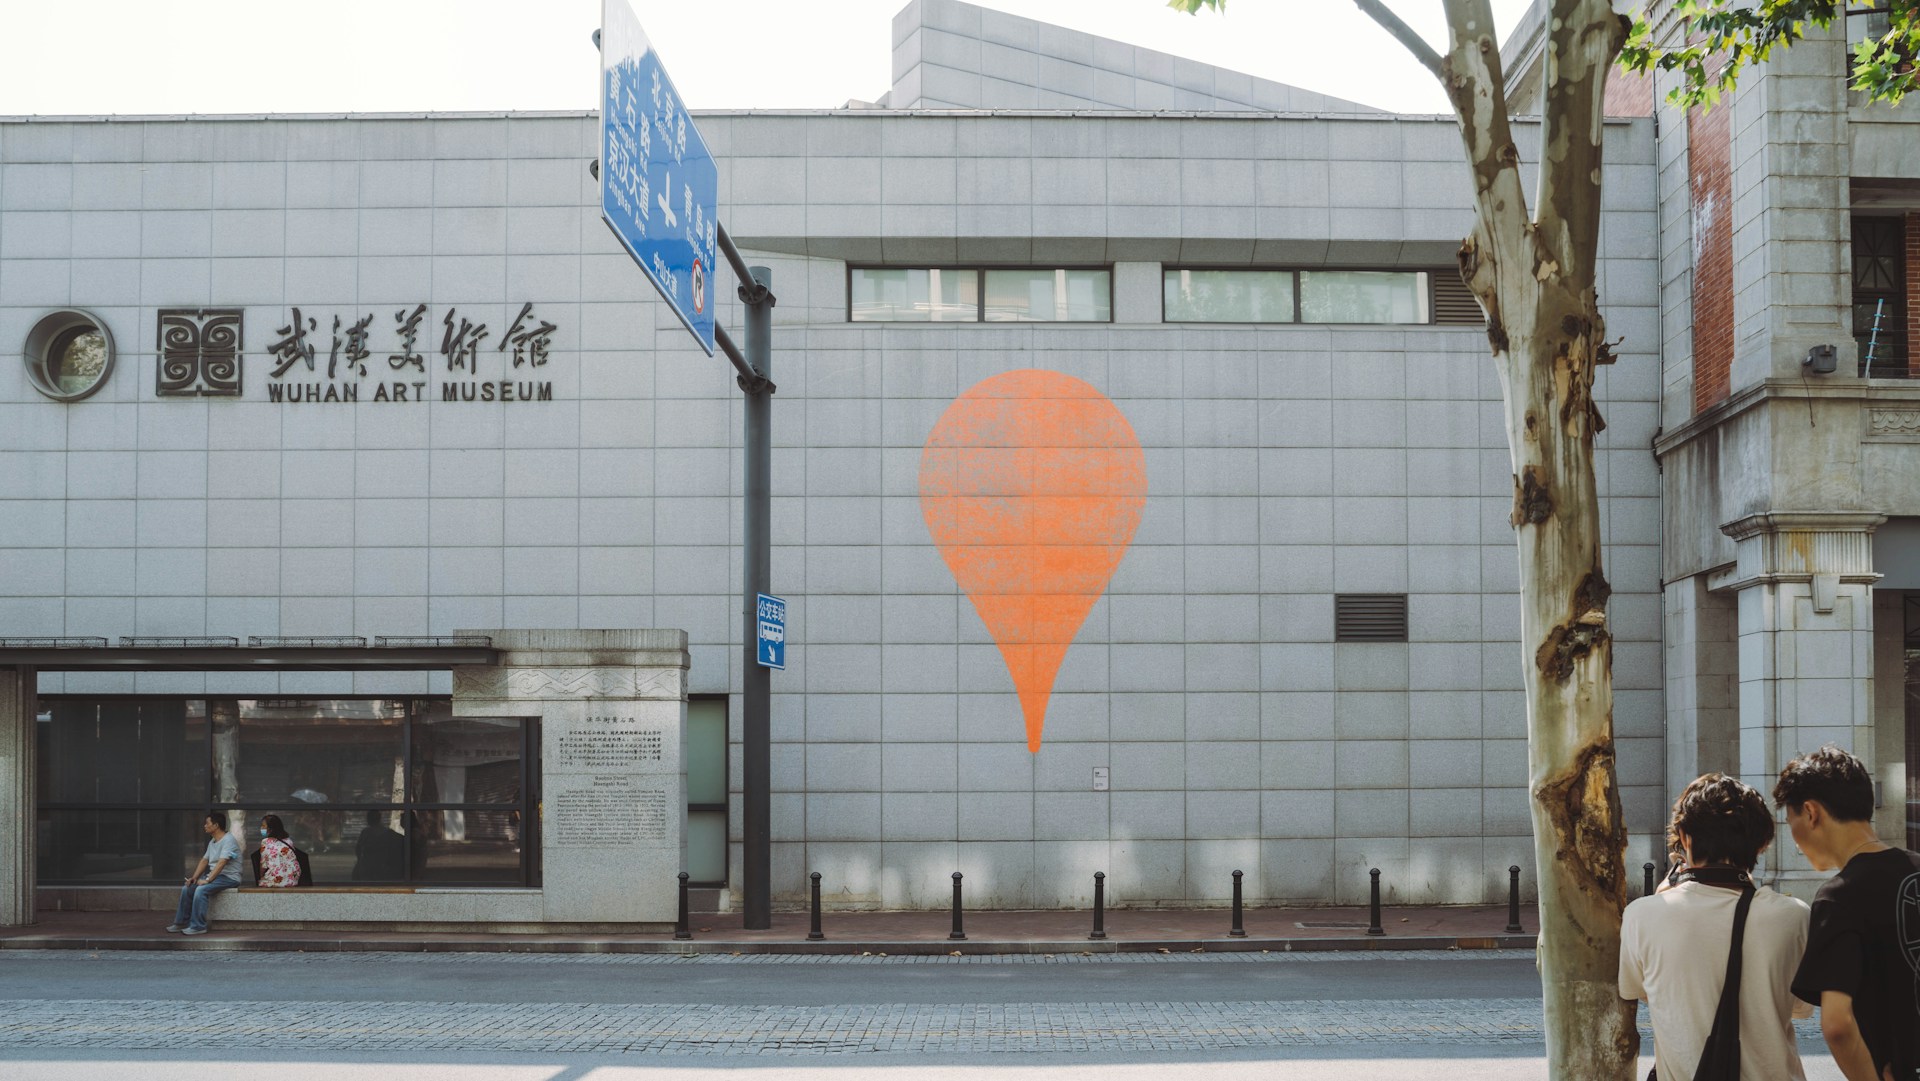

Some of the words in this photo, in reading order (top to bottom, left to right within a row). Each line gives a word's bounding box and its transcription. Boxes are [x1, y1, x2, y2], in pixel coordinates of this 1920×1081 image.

[610, 65, 650, 157] 黄石路
[652, 67, 686, 155] 北京路
[608, 130, 650, 221] 京汉大道
[639, 151, 648, 175] Rd
[674, 145, 681, 167] Rd
[608, 174, 632, 217] Jinghan
[634, 210, 647, 238] Ave.
[684, 183, 714, 257] 青岛路
[653, 251, 678, 299] 中山大道
[267, 302, 557, 379] 武漢美術館
[268, 383, 358, 402] WUHAN
[374, 382, 426, 402] ART
[442, 381, 553, 402] MUSEUM
[760, 600, 784, 623] 公交车站
